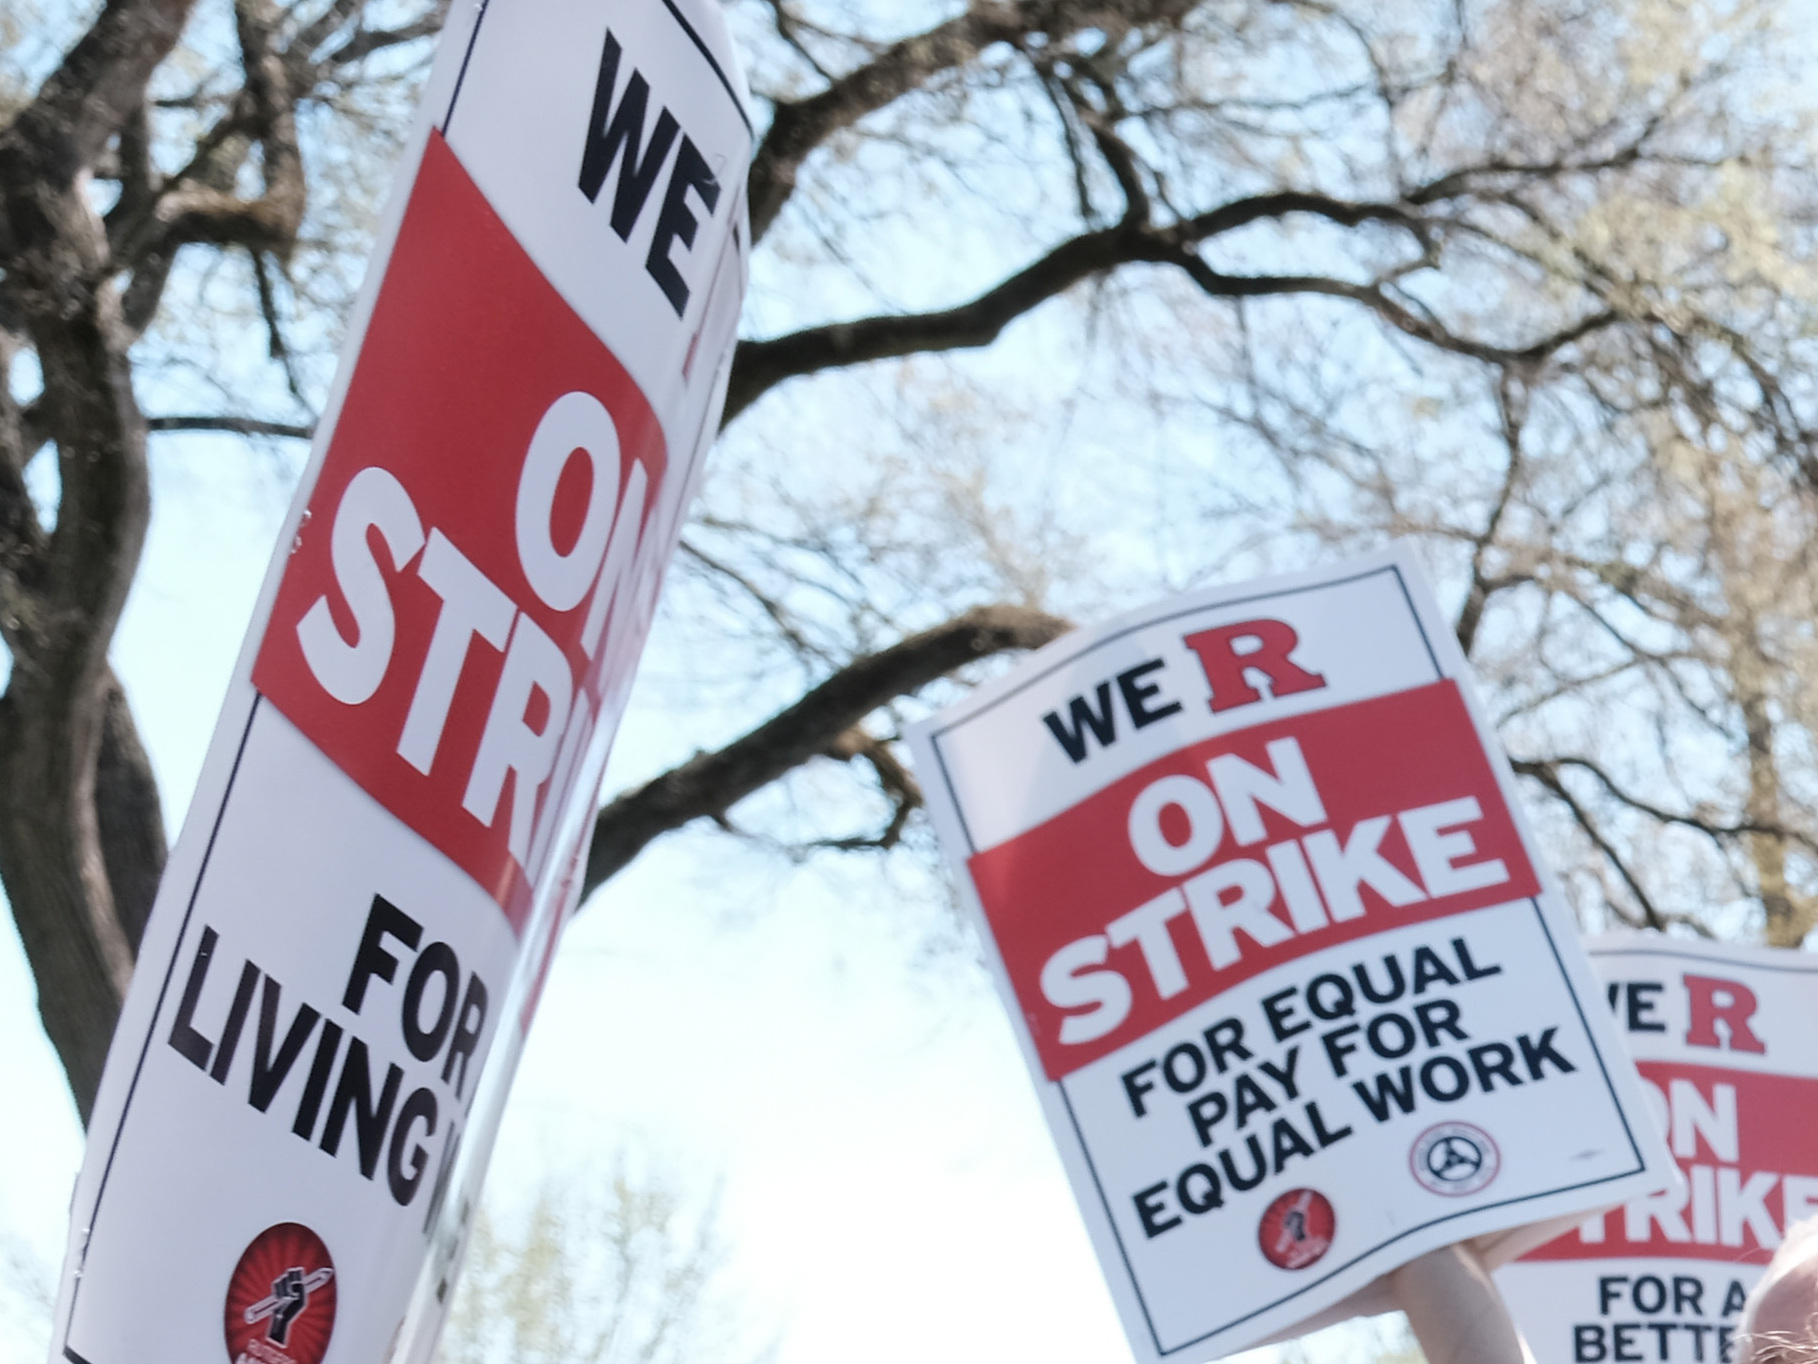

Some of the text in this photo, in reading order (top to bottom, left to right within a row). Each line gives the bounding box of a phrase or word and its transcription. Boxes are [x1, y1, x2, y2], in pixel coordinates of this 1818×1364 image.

[579, 28, 722, 320] WE
[1043, 617, 1327, 766] WE R
[1128, 736, 1327, 878] ON
[342, 893, 489, 1102] FOR
[1040, 795, 1511, 1046] STRIKE
[167, 924, 437, 1206] LIVING
[1121, 937, 1503, 1119] FOR EQUAL
[1188, 998, 1470, 1147] PAY FOR
[1683, 973, 1765, 1056] R
[1131, 1120, 1354, 1239] EQUAL
[1354, 1026, 1576, 1124] WORK
[1572, 1324, 1737, 1364] BETTE
[1599, 1275, 1752, 1317] FOR A
